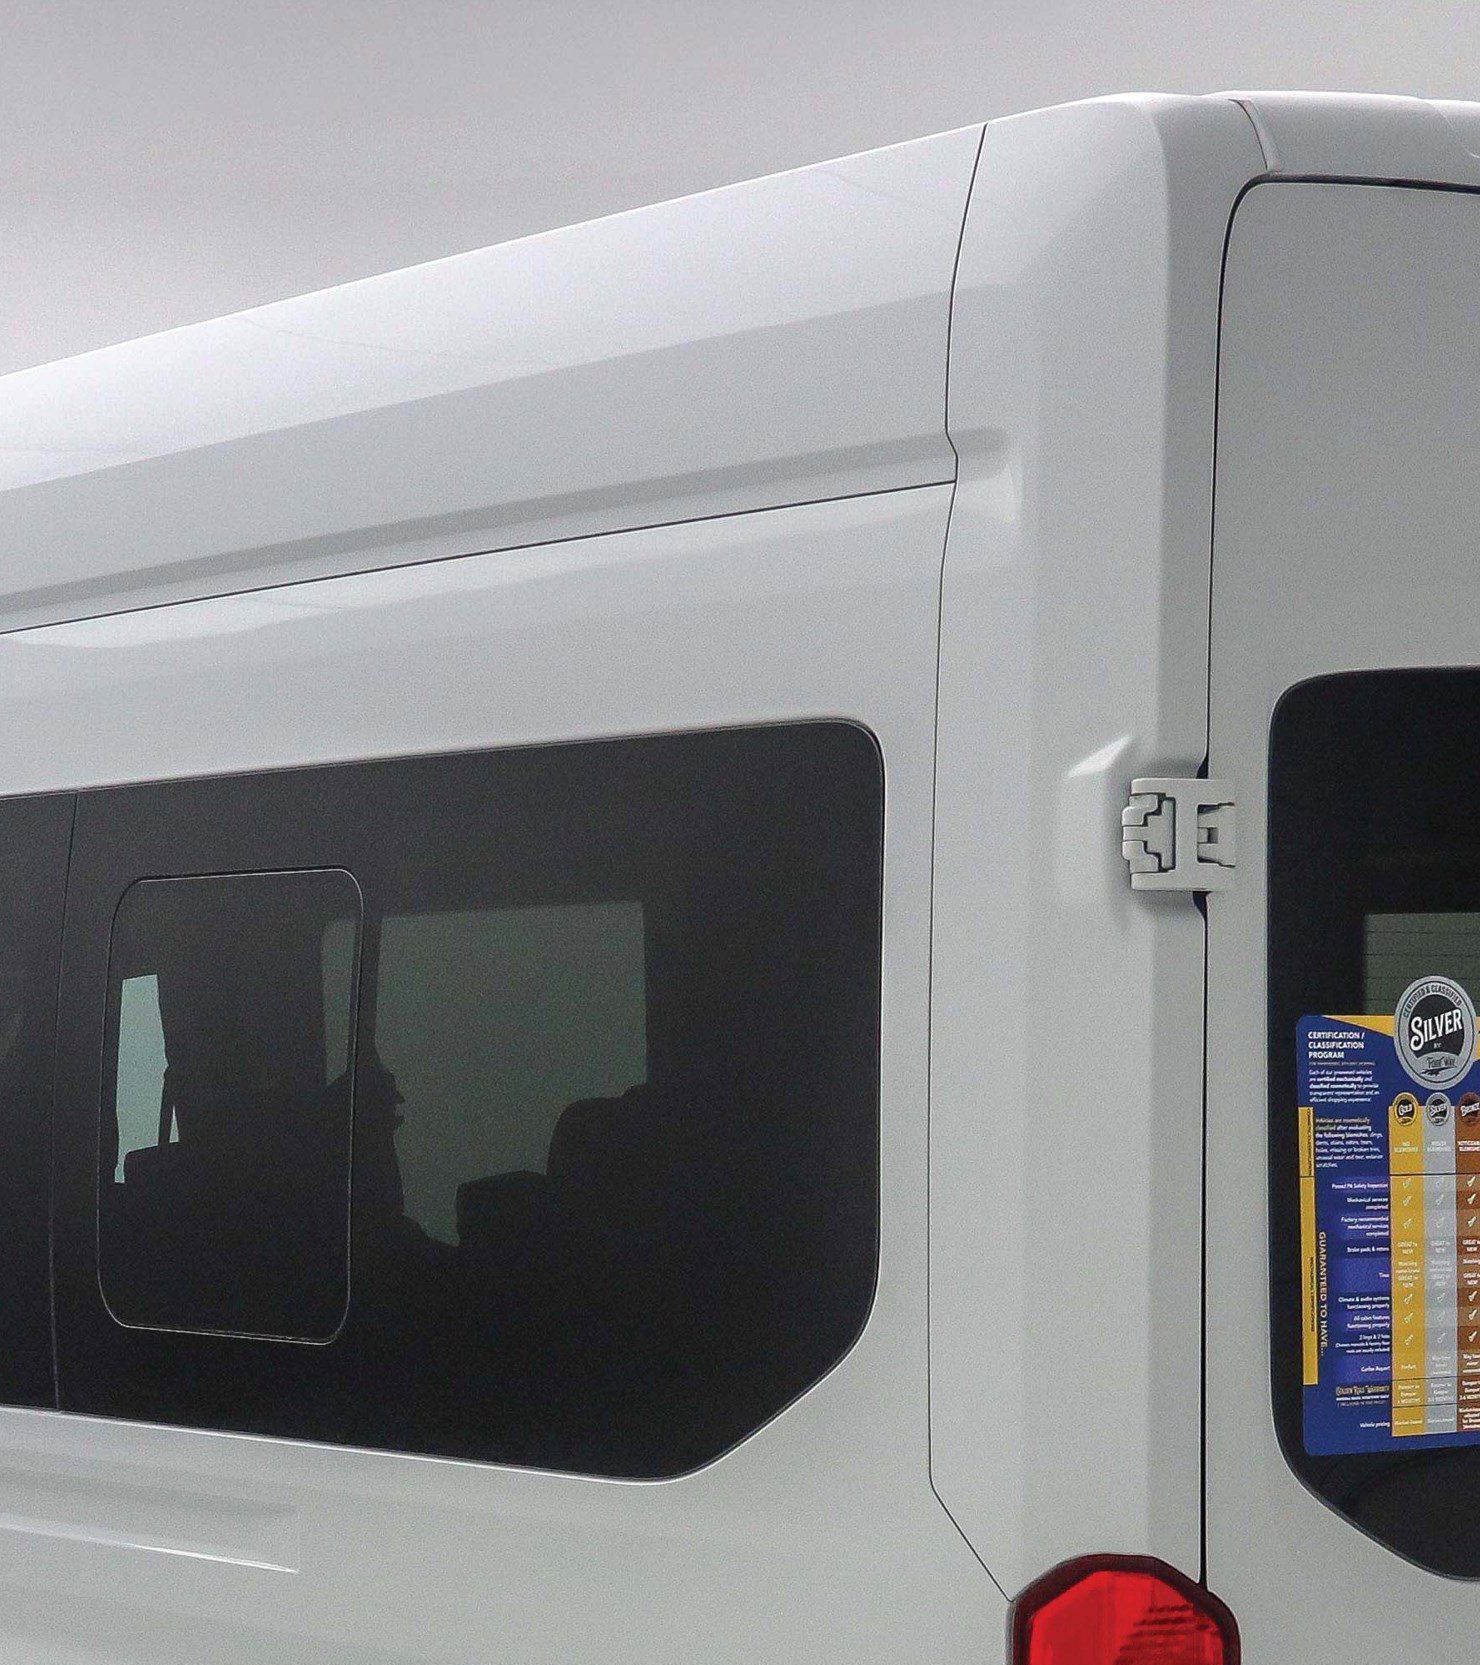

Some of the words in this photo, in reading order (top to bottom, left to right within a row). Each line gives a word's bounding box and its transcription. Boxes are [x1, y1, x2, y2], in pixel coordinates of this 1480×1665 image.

[1308, 1031, 1359, 1039] CERTIFICATION
[1410, 1008, 1463, 1051] SILVER
[1308, 1041, 1364, 1049] CLASSIFICATION
[1308, 1051, 1345, 1059] PROGRAM
[1319, 1232, 1328, 1301] GUARANTEED
[1320, 1304, 1328, 1318] TO
